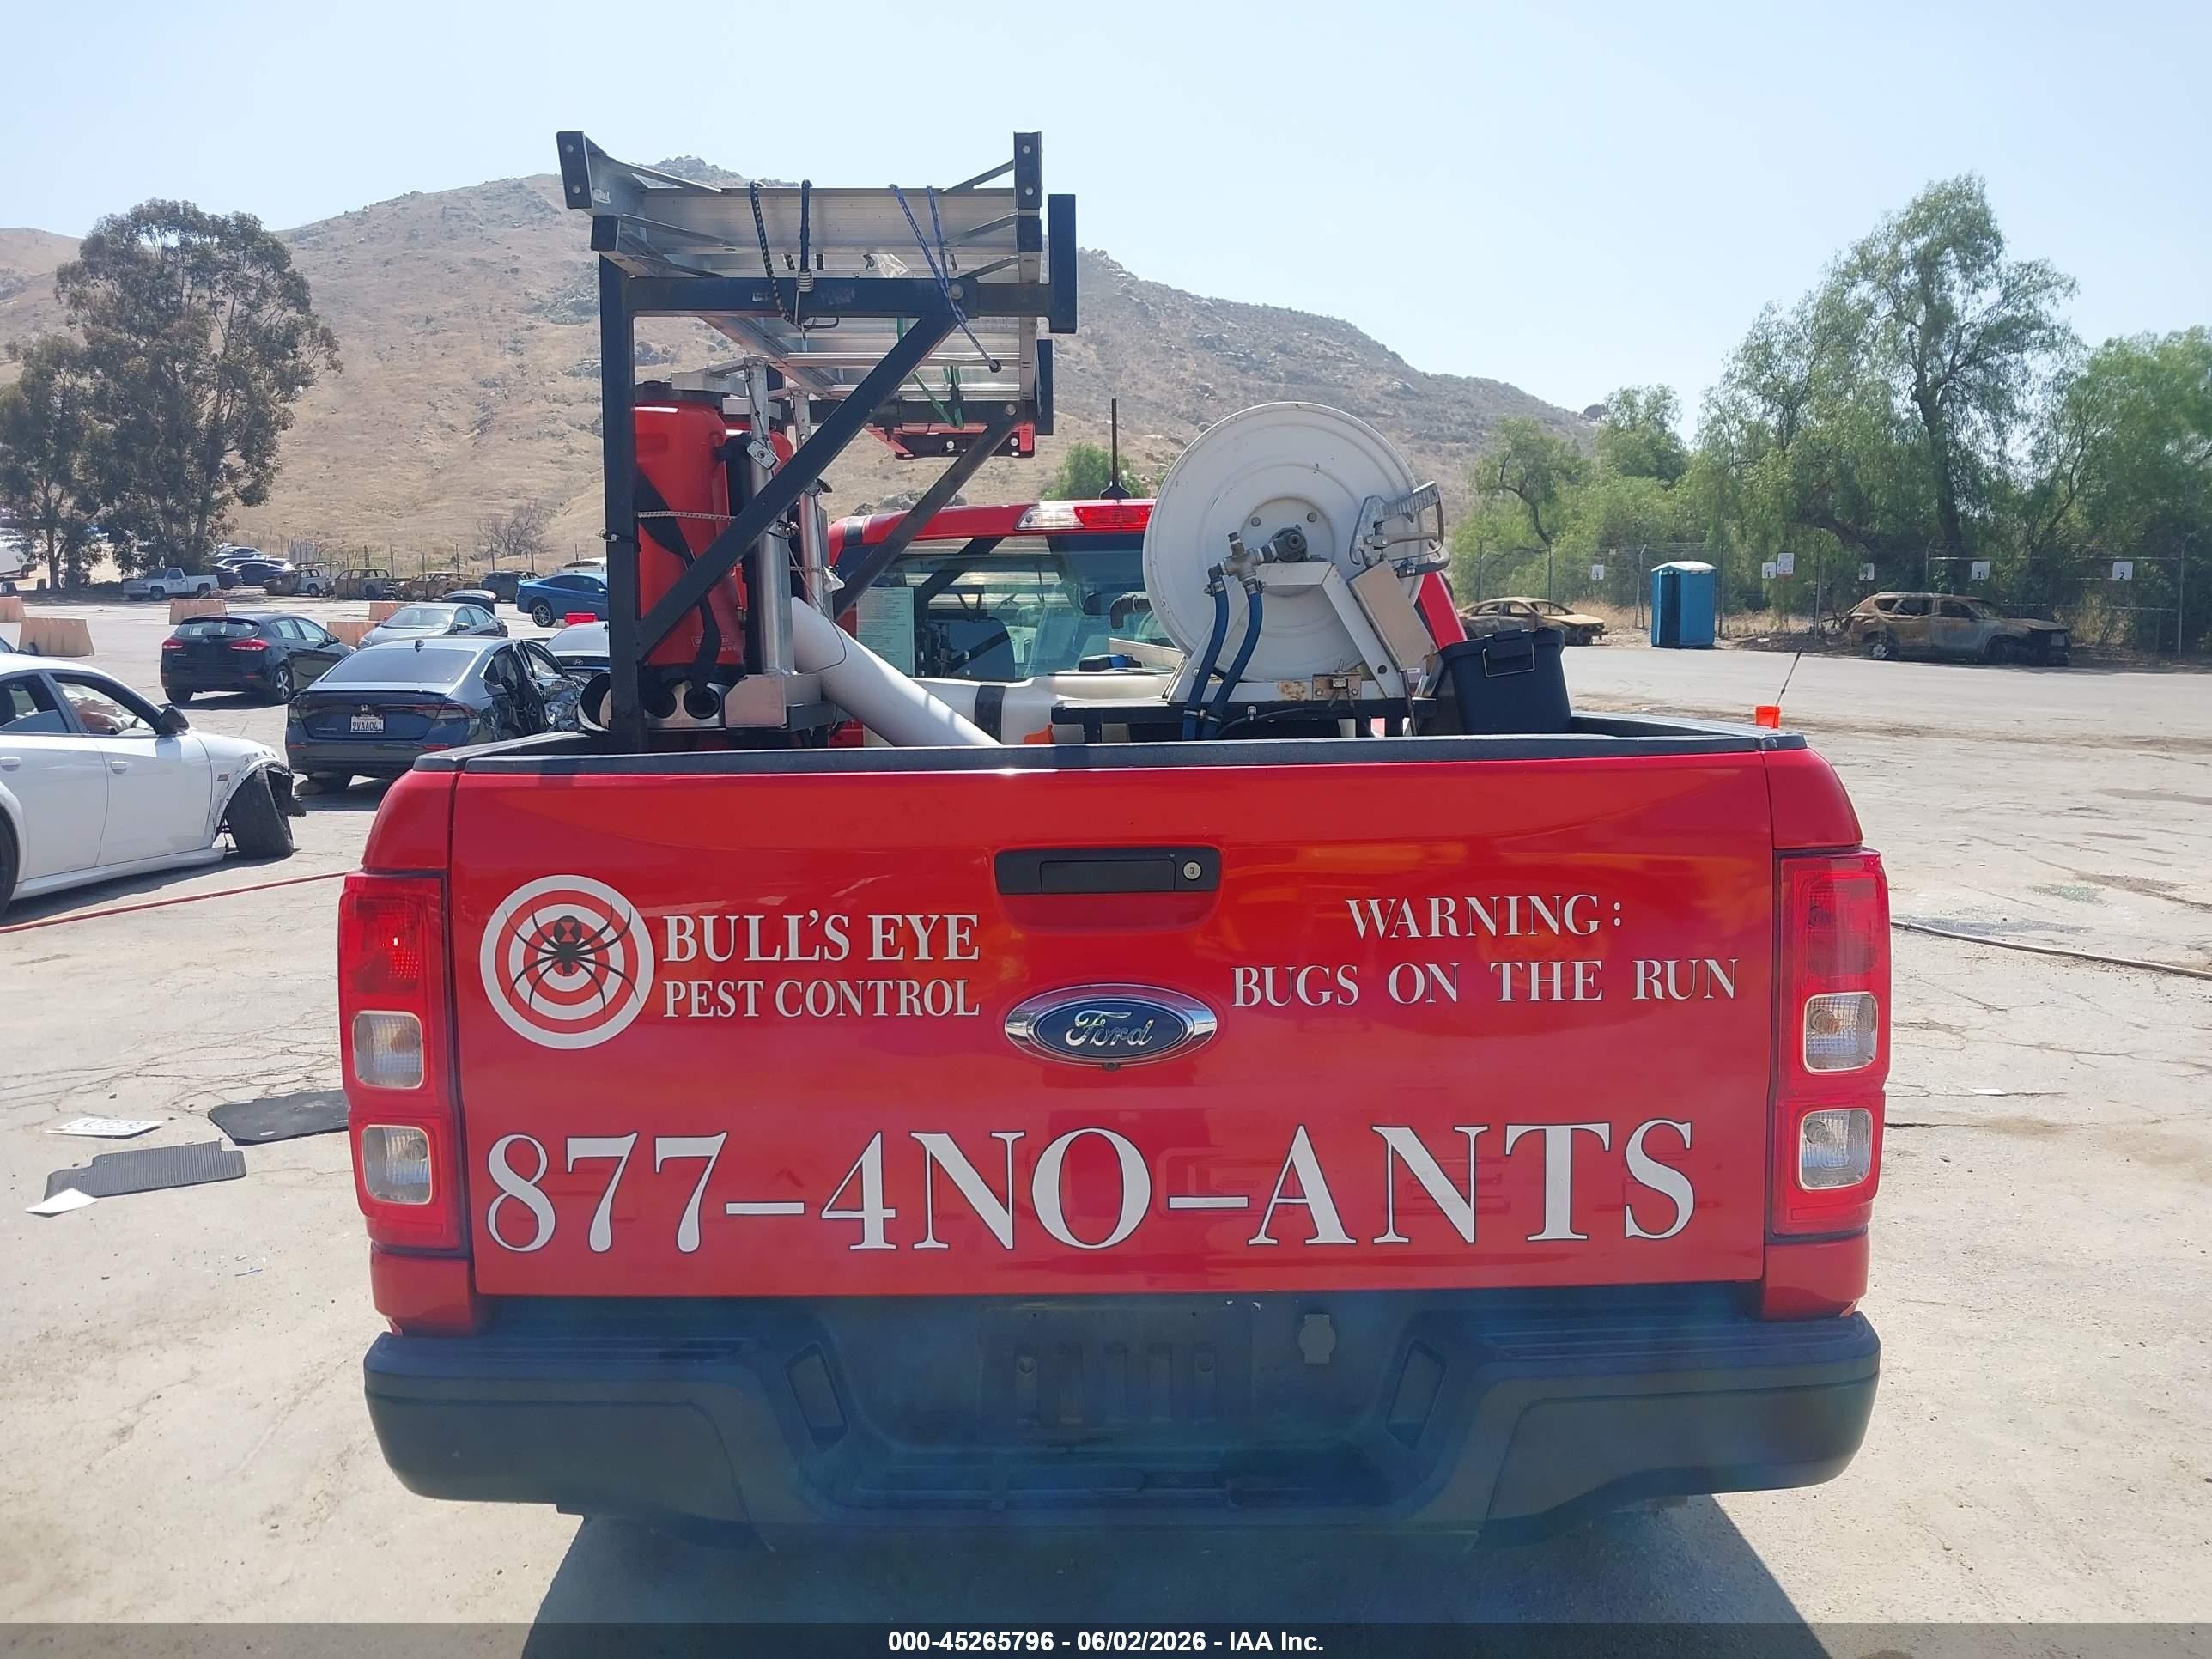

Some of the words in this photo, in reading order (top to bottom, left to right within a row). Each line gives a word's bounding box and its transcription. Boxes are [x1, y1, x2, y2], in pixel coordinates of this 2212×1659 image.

[662, 909, 850, 962] BULL'S
[867, 913, 980, 961] EYE
[1346, 894, 1621, 939] WARNING:
[663, 979, 764, 1018] PEST
[775, 979, 980, 1018] CONTROL
[1231, 964, 1359, 1007] BUGS
[1387, 962, 1461, 1004] ON
[1489, 960, 1603, 1003] THE
[1631, 958, 1739, 1000] RUN
[1065, 1010, 1154, 1046] Ford
